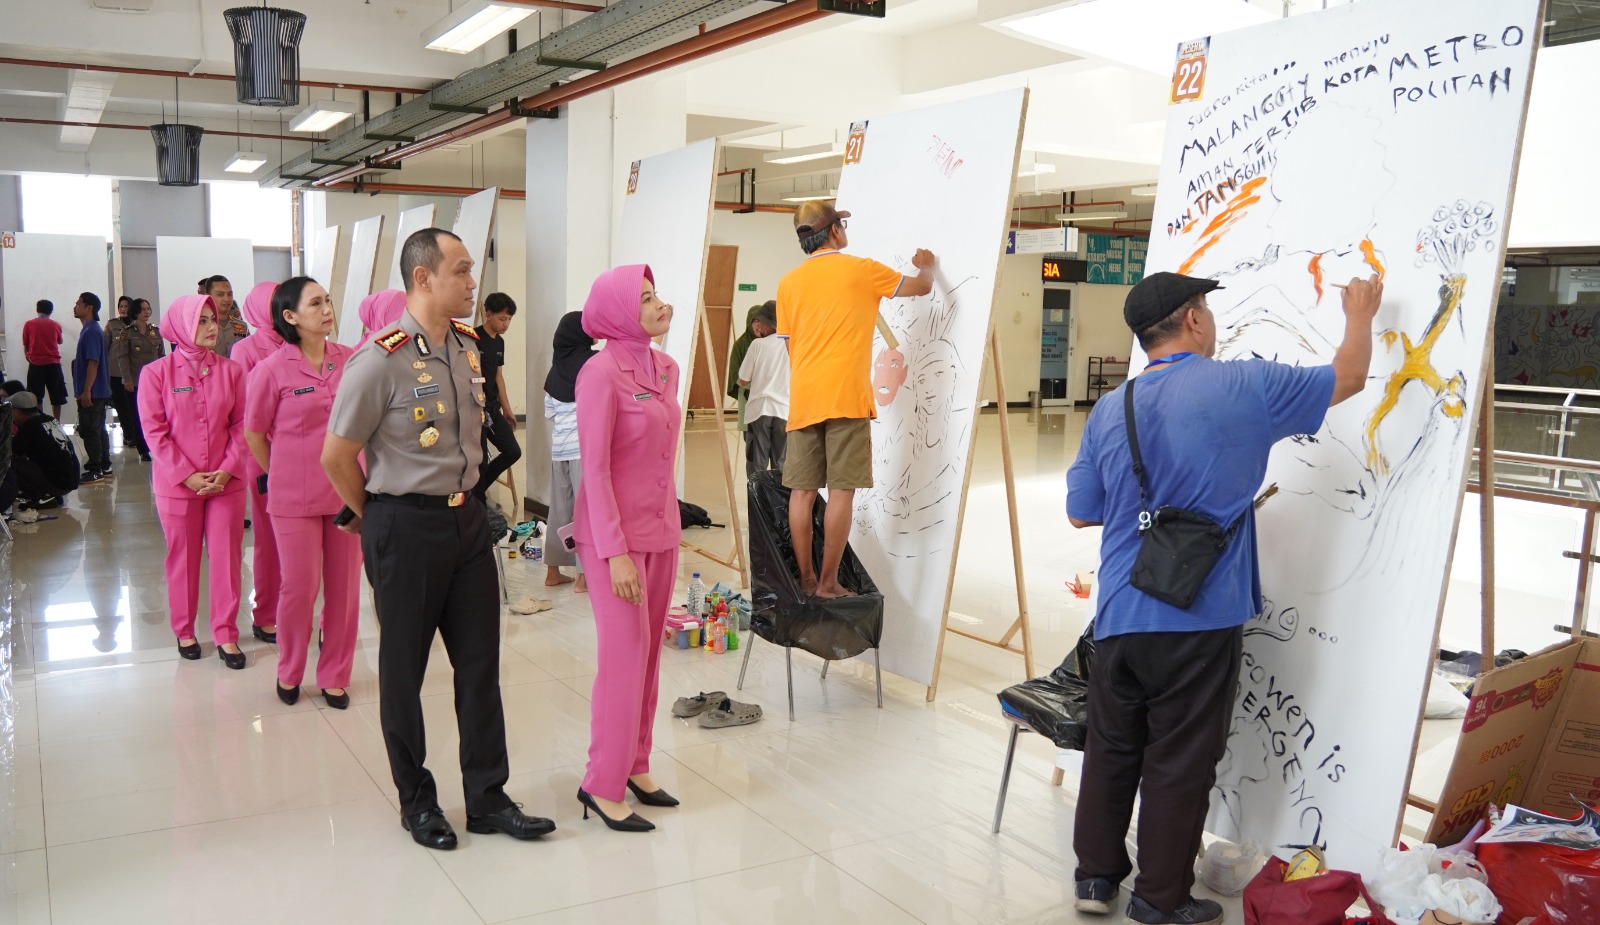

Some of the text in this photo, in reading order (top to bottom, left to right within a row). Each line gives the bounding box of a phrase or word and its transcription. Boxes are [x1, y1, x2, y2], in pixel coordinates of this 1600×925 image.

[1389, 25, 1524, 82] METRO
[1176, 60, 1203, 96] 22
[1324, 64, 1379, 93] KOTA
[847, 136, 862, 160] 21
[1187, 157, 1234, 200] AMAN
[1316, 744, 1346, 783] is
[1490, 733, 1525, 760] 2000
